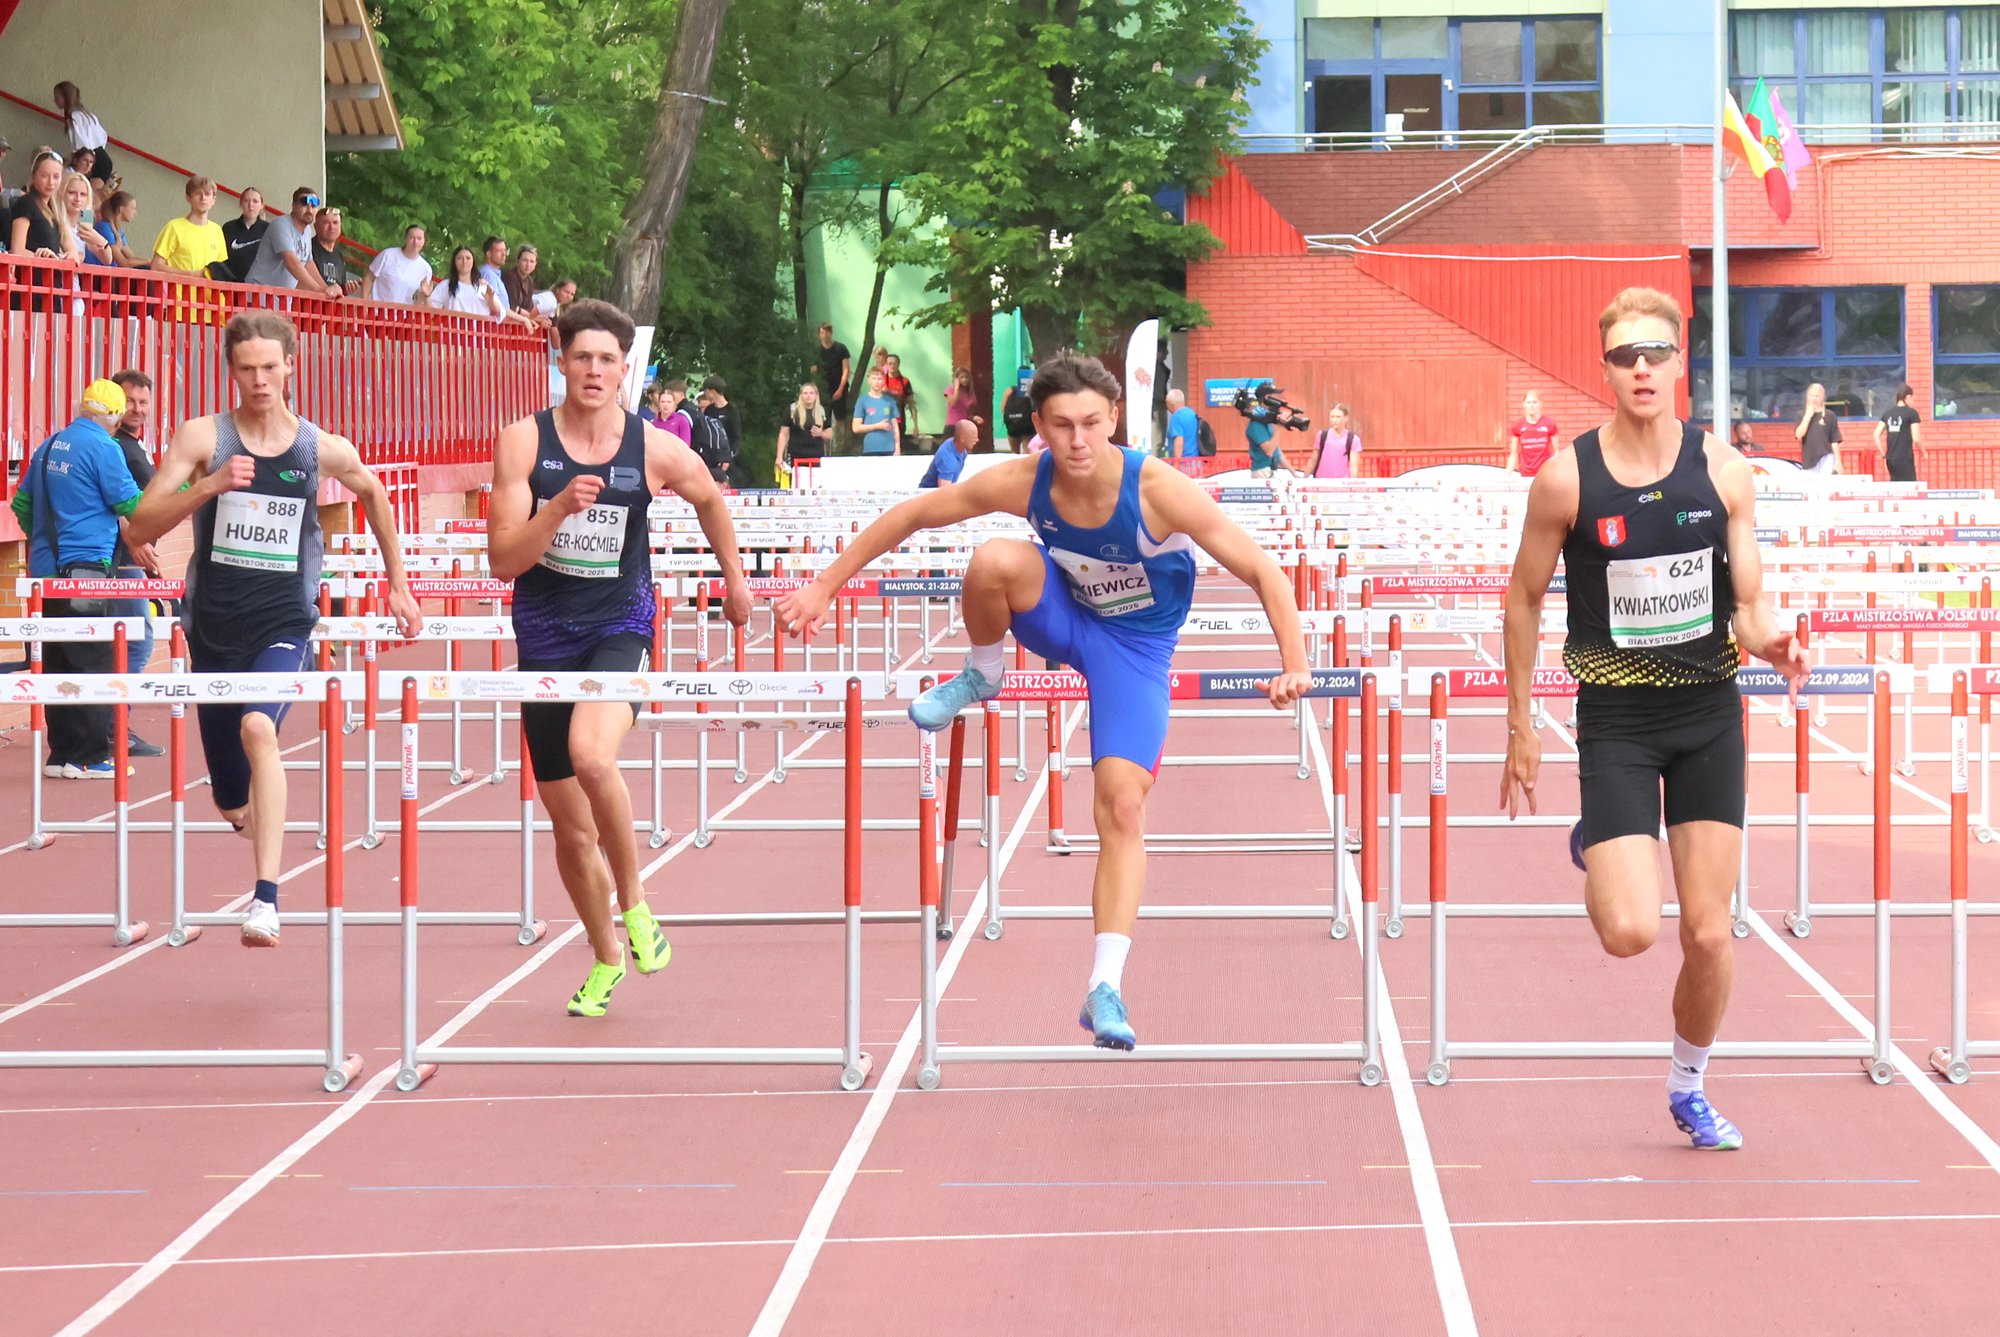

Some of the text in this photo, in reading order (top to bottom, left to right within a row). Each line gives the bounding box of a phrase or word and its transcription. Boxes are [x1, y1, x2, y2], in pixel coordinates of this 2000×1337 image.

[543, 460, 564, 470] esa
[1638, 490, 1663, 503] esa
[267, 501, 298, 517] 888
[1688, 510, 1712, 518] FOBOS
[587, 509, 618, 525] 855
[226, 522, 288, 545] HUBAR
[224, 556, 265, 568] BIAŁYSTOK
[545, 559, 586, 575] BIAŁYSTOK
[1669, 556, 1704, 578] 624
[52, 580, 181, 590] PZLA MISTRZOSTWA POLSKI
[412, 582, 478, 591] MISTRZOSTWA
[848, 580, 866, 589] U16
[885, 582, 962, 592] BIAŁYSTOK, 21-22.09.
[1382, 577, 1509, 587] PZLA MISTRZOSTWA POLSKI
[1613, 585, 1709, 616] KWIATKOWSKI
[1822, 613, 1849, 622] PZLA
[1853, 611, 1934, 622] MISTRZOSTWA
[1937, 610, 1977, 621] POLSKI
[1200, 621, 1232, 630] FUEL
[1627, 629, 1701, 646] BIAŁYSTOK 2025
[1464, 672, 1499, 688] PZLA
[1735, 673, 1870, 686] AŁYSTOK, -22.09.2024
[155, 684, 196, 697] FUEL
[239, 684, 268, 693] Okęcie
[676, 684, 718, 695] FUEL
[759, 683, 788, 692] Okęcie
[404, 743, 415, 785] polanik
[922, 743, 933, 784] polanik
[1434, 739, 1445, 780] polanik
